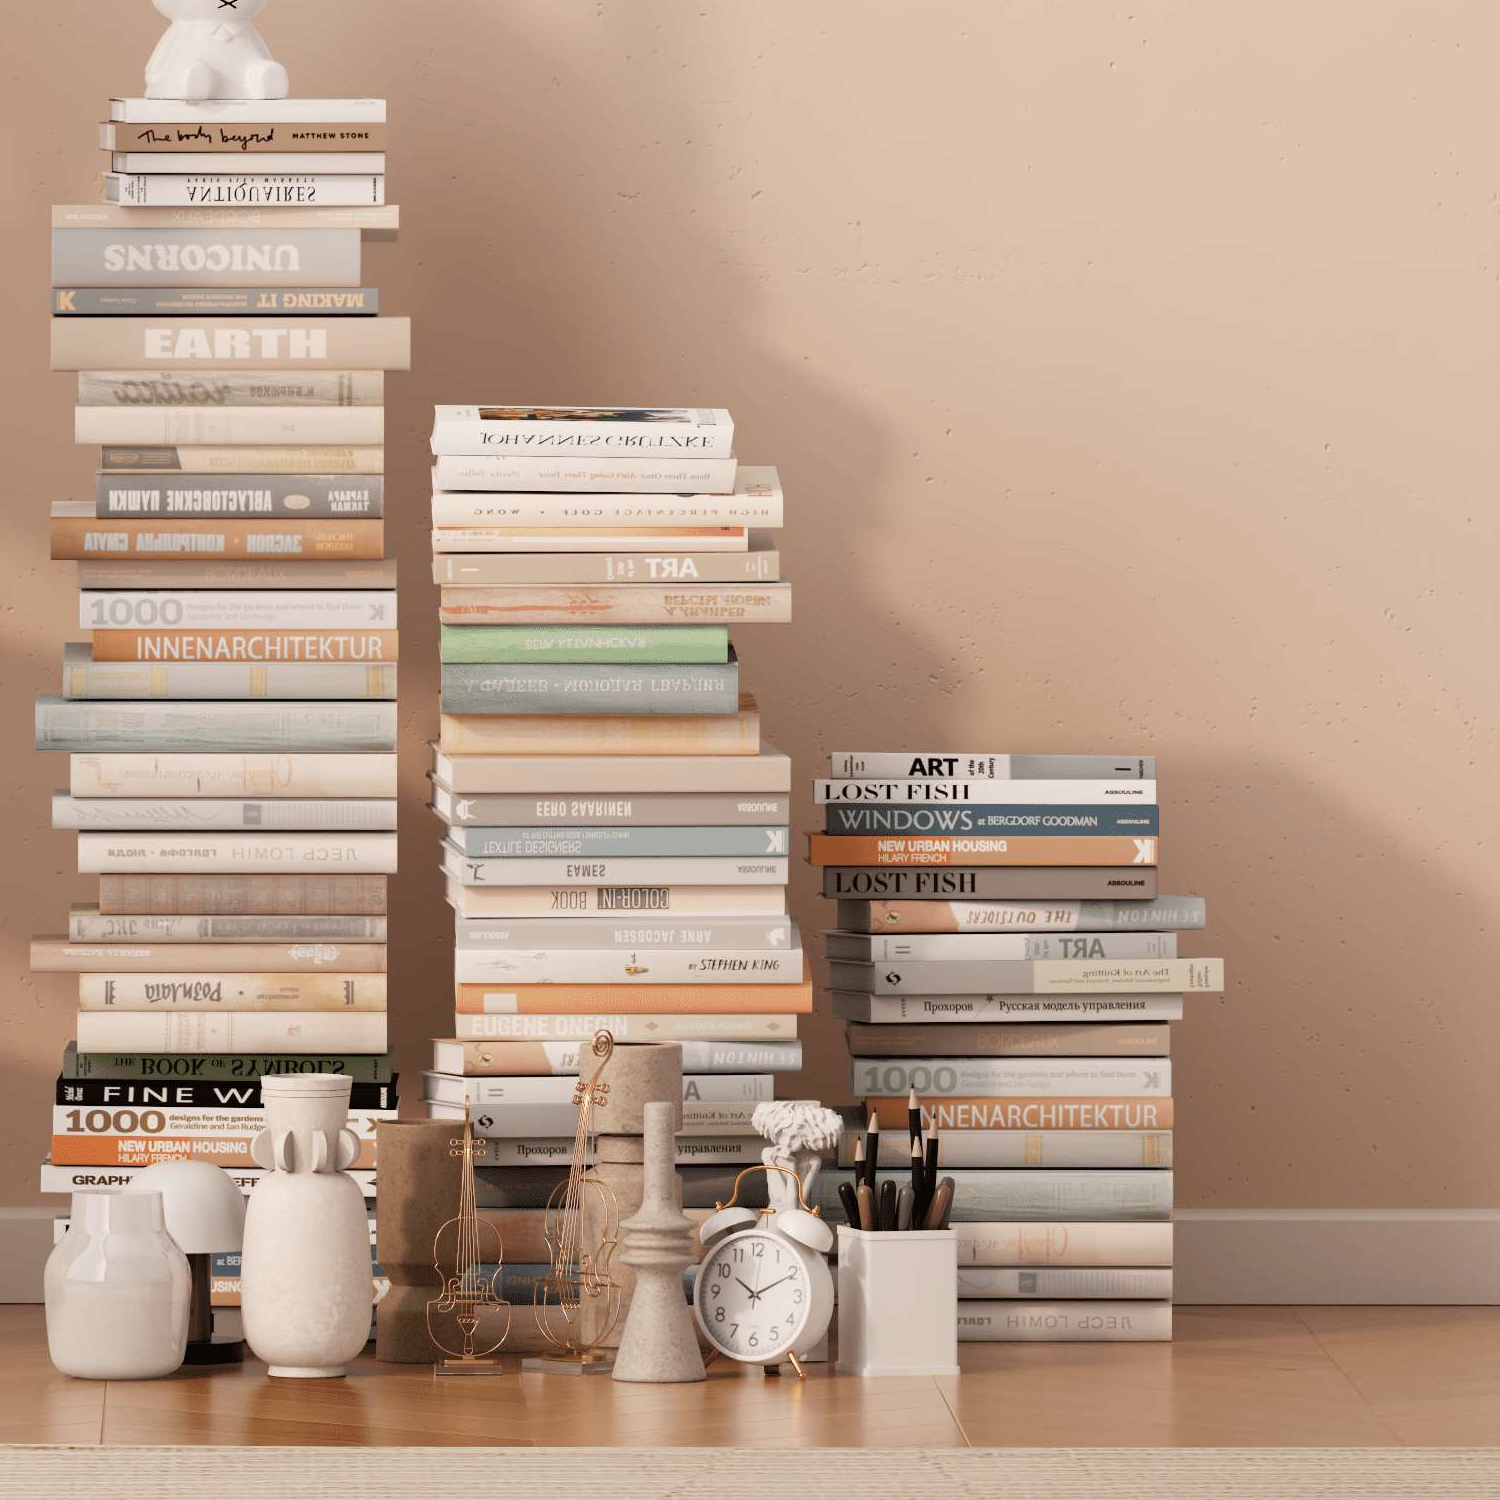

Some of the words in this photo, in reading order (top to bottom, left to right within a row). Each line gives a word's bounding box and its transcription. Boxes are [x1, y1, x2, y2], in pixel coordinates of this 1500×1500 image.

[137, 126, 172, 143] The
[177, 125, 212, 144] body
[220, 128, 274, 150] beyond
[104, 244, 300, 271] UNICORNS
[256, 293, 279, 308] IT
[283, 293, 365, 308] MAKING
[144, 329, 327, 358] EARTH
[205, 567, 287, 581] BORDEAUX
[90, 598, 184, 626] 1000
[137, 636, 383, 660] INNENARCHITEKTUR
[908, 758, 959, 777] ART
[987, 757, 996, 778] Century
[824, 784, 899, 800] LOST
[905, 784, 971, 800] FISH
[837, 809, 973, 831] WINDOWS
[977, 817, 986, 826] at
[987, 815, 1041, 826] BERGDORF
[1042, 815, 1098, 827] GOODMAN
[877, 840, 906, 852] NEW
[908, 840, 951, 853] URBAN
[953, 840, 1007, 853] HOUSING
[878, 853, 909, 863] HILARY
[910, 853, 947, 863] FRENCH
[835, 872, 908, 893] LOST
[914, 872, 978, 893] FISH
[550, 891, 587, 910] BOOK
[966, 910, 1037, 924] OUTSIDERS
[1044, 910, 1072, 923] THE
[1117, 911, 1178, 923] HINTON
[469, 931, 509, 939] ASSOULINE
[614, 930, 676, 943] JACOBSEN
[681, 930, 711, 943] ARNE
[699, 958, 748, 971] STEPHEN
[752, 958, 780, 971] KING
[923, 1001, 973, 1014] Прохоров
[999, 1000, 1040, 1014] Русская
[1041, 1001, 1080, 1012] модель
[1082, 1000, 1146, 1013] управления
[471, 1016, 549, 1037] EUGENE
[555, 1016, 628, 1037] ONEGIN
[674, 1022, 716, 1030] ALEXANDR
[718, 1022, 754, 1030] PUSHKIN
[977, 1034, 1060, 1048] BORDEAUX
[1118, 1037, 1158, 1045] ASSOULINE
[864, 1066, 958, 1092] 1000
[960, 1070, 989, 1081] designs
[990, 1070, 1002, 1079] for
[1003, 1070, 1016, 1079] the
[1017, 1070, 1047, 1081] gardens
[1049, 1070, 1063, 1079] and
[1064, 1070, 1089, 1079] where
[1091, 1070, 1098, 1079] to
[1100, 1070, 1117, 1079] find
[1119, 1070, 1136, 1079] them
[103, 1086, 194, 1103] FINE
[65, 1109, 166, 1133] 1000
[169, 1114, 199, 1123] designs
[201, 1114, 214, 1122] for
[216, 1114, 230, 1122] the
[232, 1115, 264, 1125] gardens
[920, 1104, 1158, 1128] NNENARCHITEKTUR
[170, 1122, 205, 1130] Geraldine
[207, 1122, 223, 1131] and
[226, 1123, 239, 1131] Ian
[118, 1140, 146, 1152] NEW
[148, 1141, 190, 1153] URBAN
[193, 1142, 248, 1154] HOUSING
[517, 1143, 568, 1157] Прохоров
[677, 1142, 742, 1156] управления
[118, 1153, 149, 1163] HILARY
[151, 1153, 187, 1162] FRENCH
[72, 1174, 133, 1186] GRAPH
[733, 1248, 744, 1262] 11
[750, 1242, 765, 1257] 12
[775, 1250, 781, 1263] 1
[717, 1263, 732, 1278] 10
[788, 1265, 799, 1280] 2
[711, 1284, 721, 1299] 9
[793, 1289, 803, 1304] 3
[715, 1307, 726, 1322] 8
[786, 1312, 795, 1325] 4
[730, 1323, 740, 1338] 7
[769, 1326, 780, 1341] 5
[748, 1331, 759, 1347] 6
